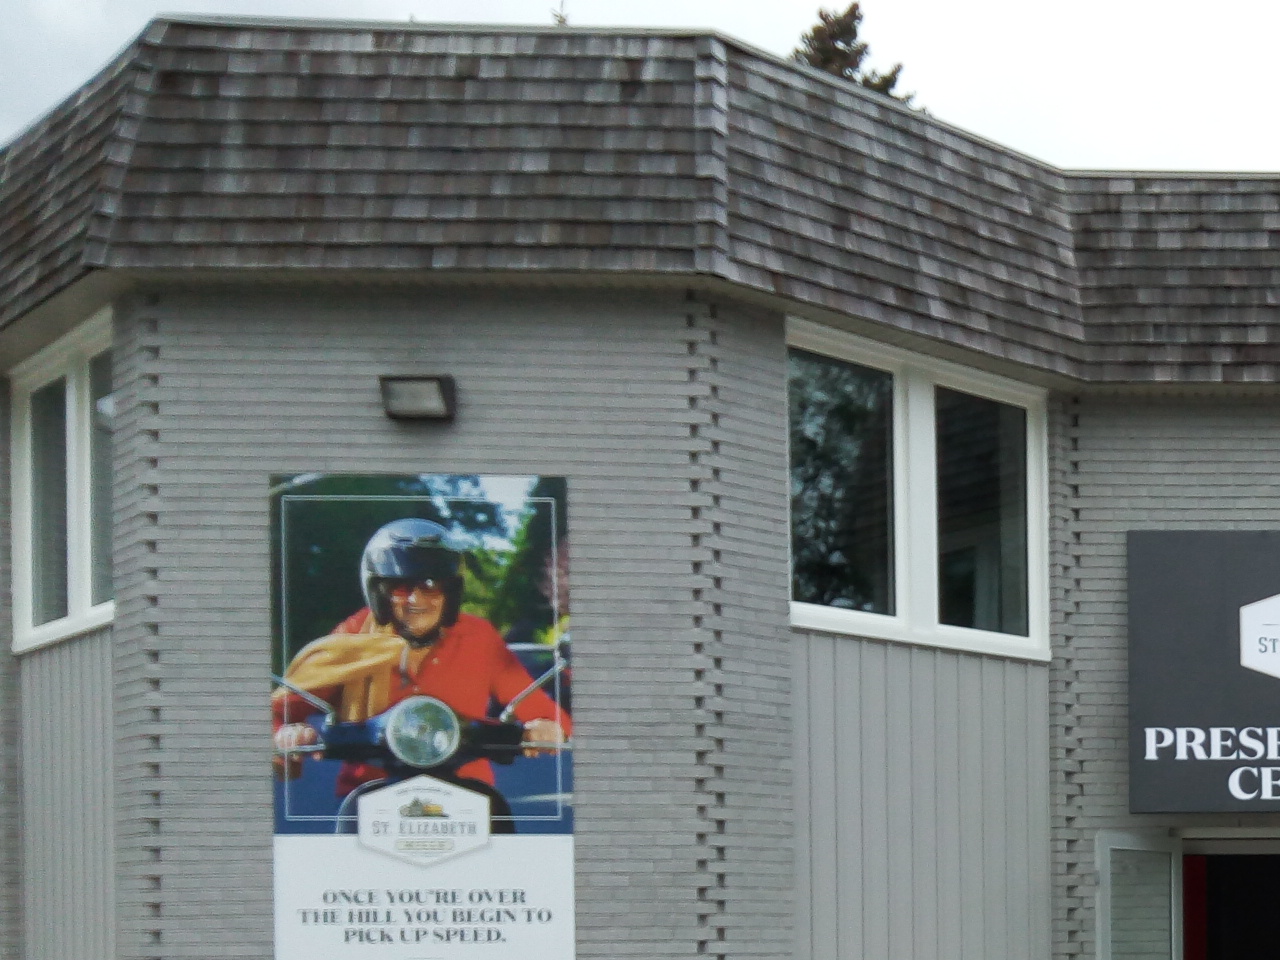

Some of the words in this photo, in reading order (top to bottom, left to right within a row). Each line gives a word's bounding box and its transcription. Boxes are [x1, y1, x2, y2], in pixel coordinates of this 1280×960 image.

[398, 821, 477, 835] ELIZABETH
[322, 889, 377, 905] ONCE
[385, 889, 460, 905] YOU'RE
[468, 889, 527, 905] OVER
[300, 908, 342, 925] THE
[347, 908, 400, 925] HILL
[403, 908, 449, 925] YOU
[451, 908, 518, 925] BEGIN
[521, 908, 553, 925] TO
[343, 927, 394, 945] PICK
[399, 927, 430, 945] UP
[432, 927, 507, 945] SPEED.
